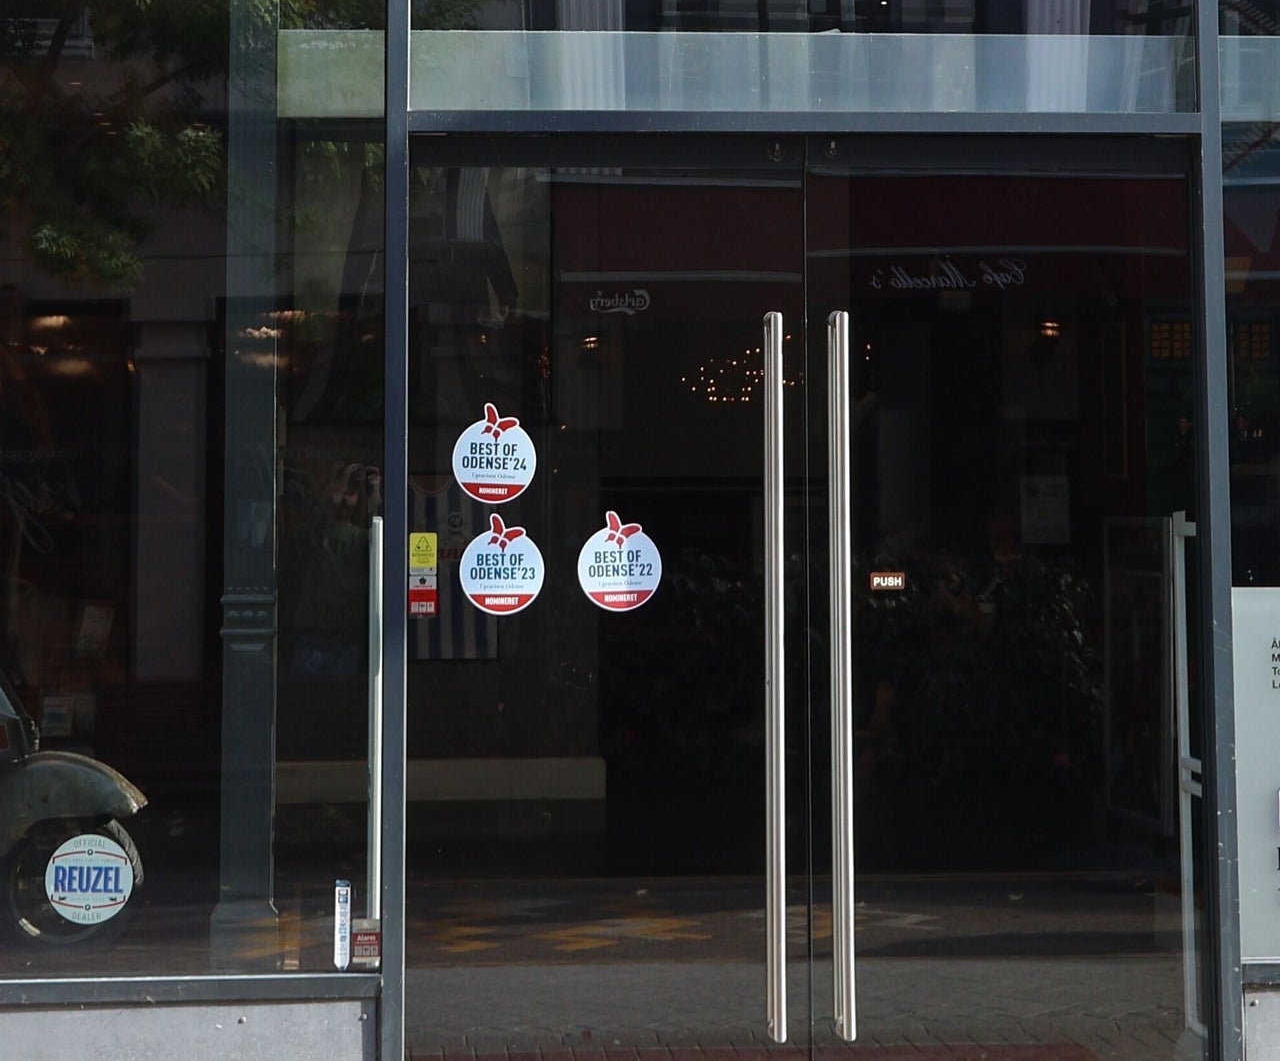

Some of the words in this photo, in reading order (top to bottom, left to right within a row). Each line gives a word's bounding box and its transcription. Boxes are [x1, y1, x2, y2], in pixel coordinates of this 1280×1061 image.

[470, 442, 500, 456] BEST
[503, 443, 518, 457] OF
[478, 487, 508, 495] NOMINERET
[476, 553, 506, 566] BEST
[509, 553, 524, 566] OF
[594, 550, 624, 564] BEST
[627, 549, 642, 563] OF
[873, 576, 902, 587] PUSH
[485, 597, 519, 606] NOMINERET
[603, 593, 638, 602] NOMINERET
[73, 837, 106, 849] OFFICIAL
[53, 865, 124, 894] REUZEL
[71, 911, 102, 922] DEALER
